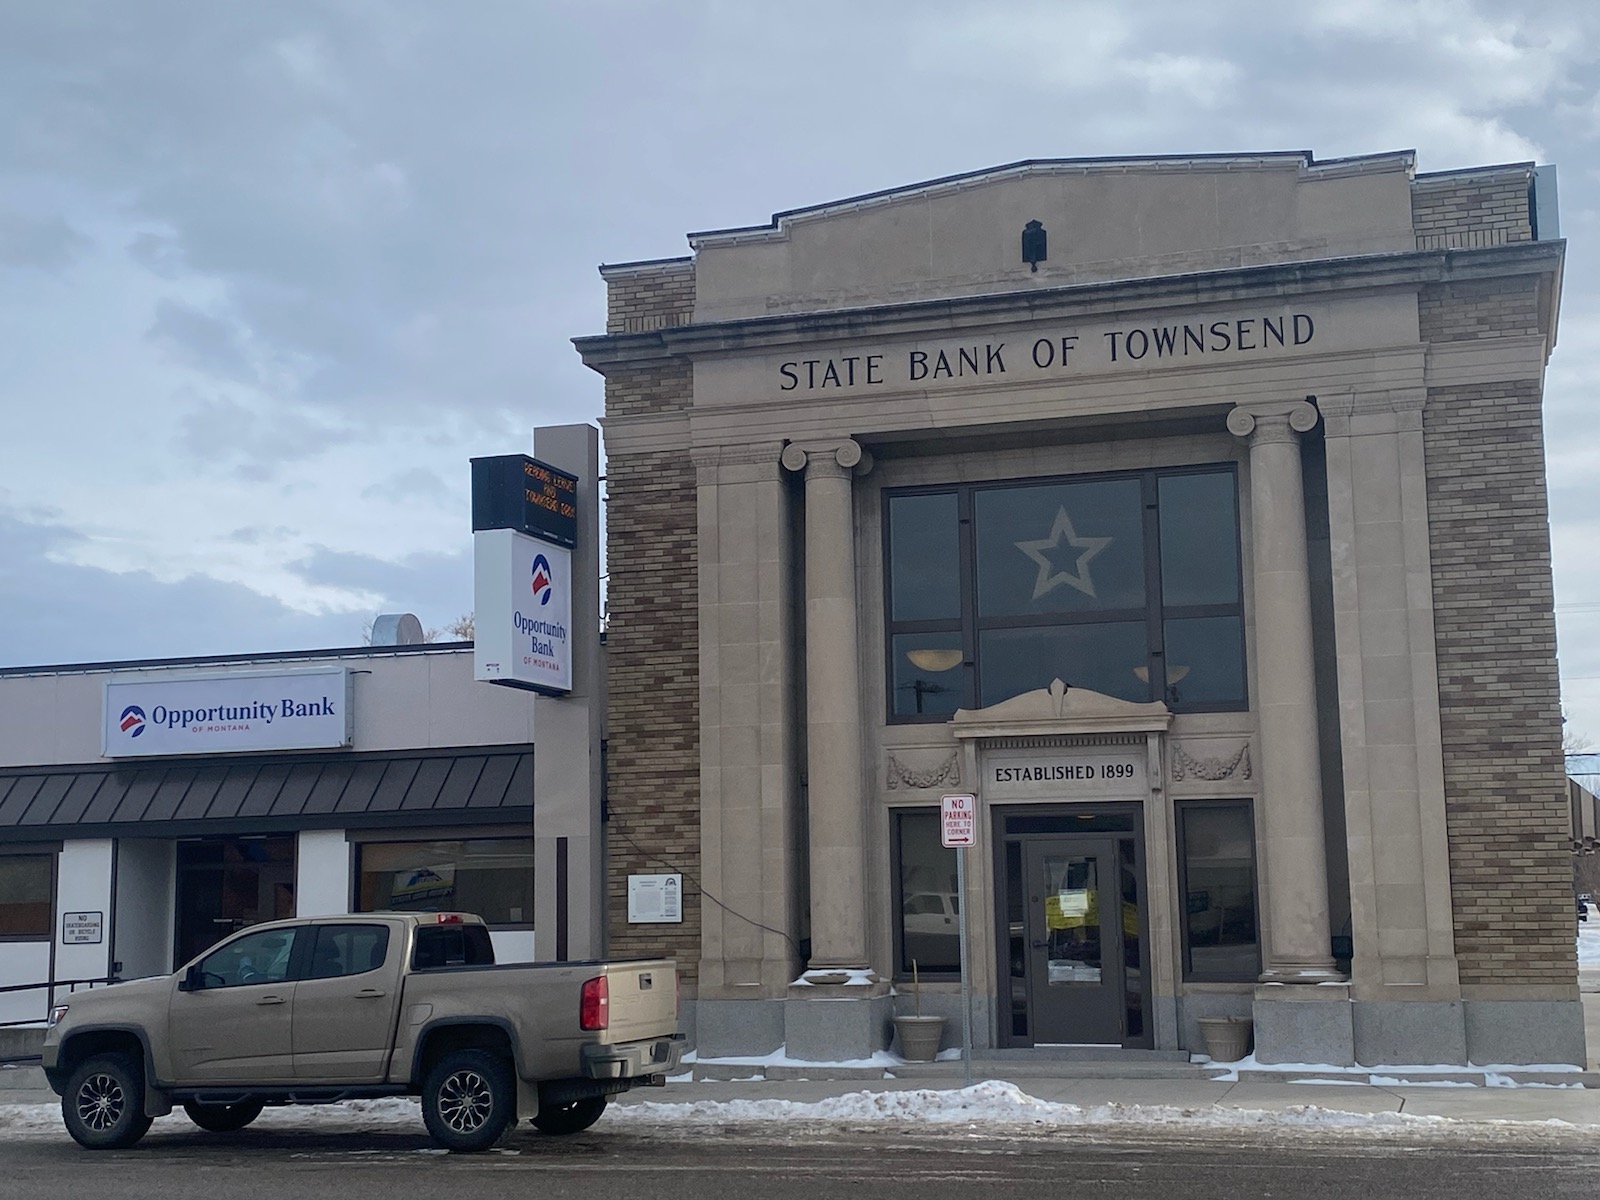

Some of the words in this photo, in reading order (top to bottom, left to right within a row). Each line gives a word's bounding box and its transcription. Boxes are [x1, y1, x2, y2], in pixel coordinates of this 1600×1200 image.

[779, 354, 884, 392] STATE
[908, 343, 1007, 382] BANK
[1032, 336, 1079, 369] OF
[1104, 313, 1315, 363] TOWNSEND
[514, 610, 567, 644] Opportunity
[532, 636, 555, 657] Bank
[524, 656, 532, 666] OF
[533, 658, 560, 671] MONTANA
[152, 700, 277, 728] Opportunity
[281, 696, 335, 718] Bank
[192, 725, 204, 733] OF
[208, 724, 250, 733] MONTANA
[995, 765, 1095, 782] ESTABLISHED
[1101, 764, 1134, 779] 1899
[951, 799, 964, 809] NO
[945, 810, 972, 820] PARKING
[947, 828, 971, 836] CORNER
